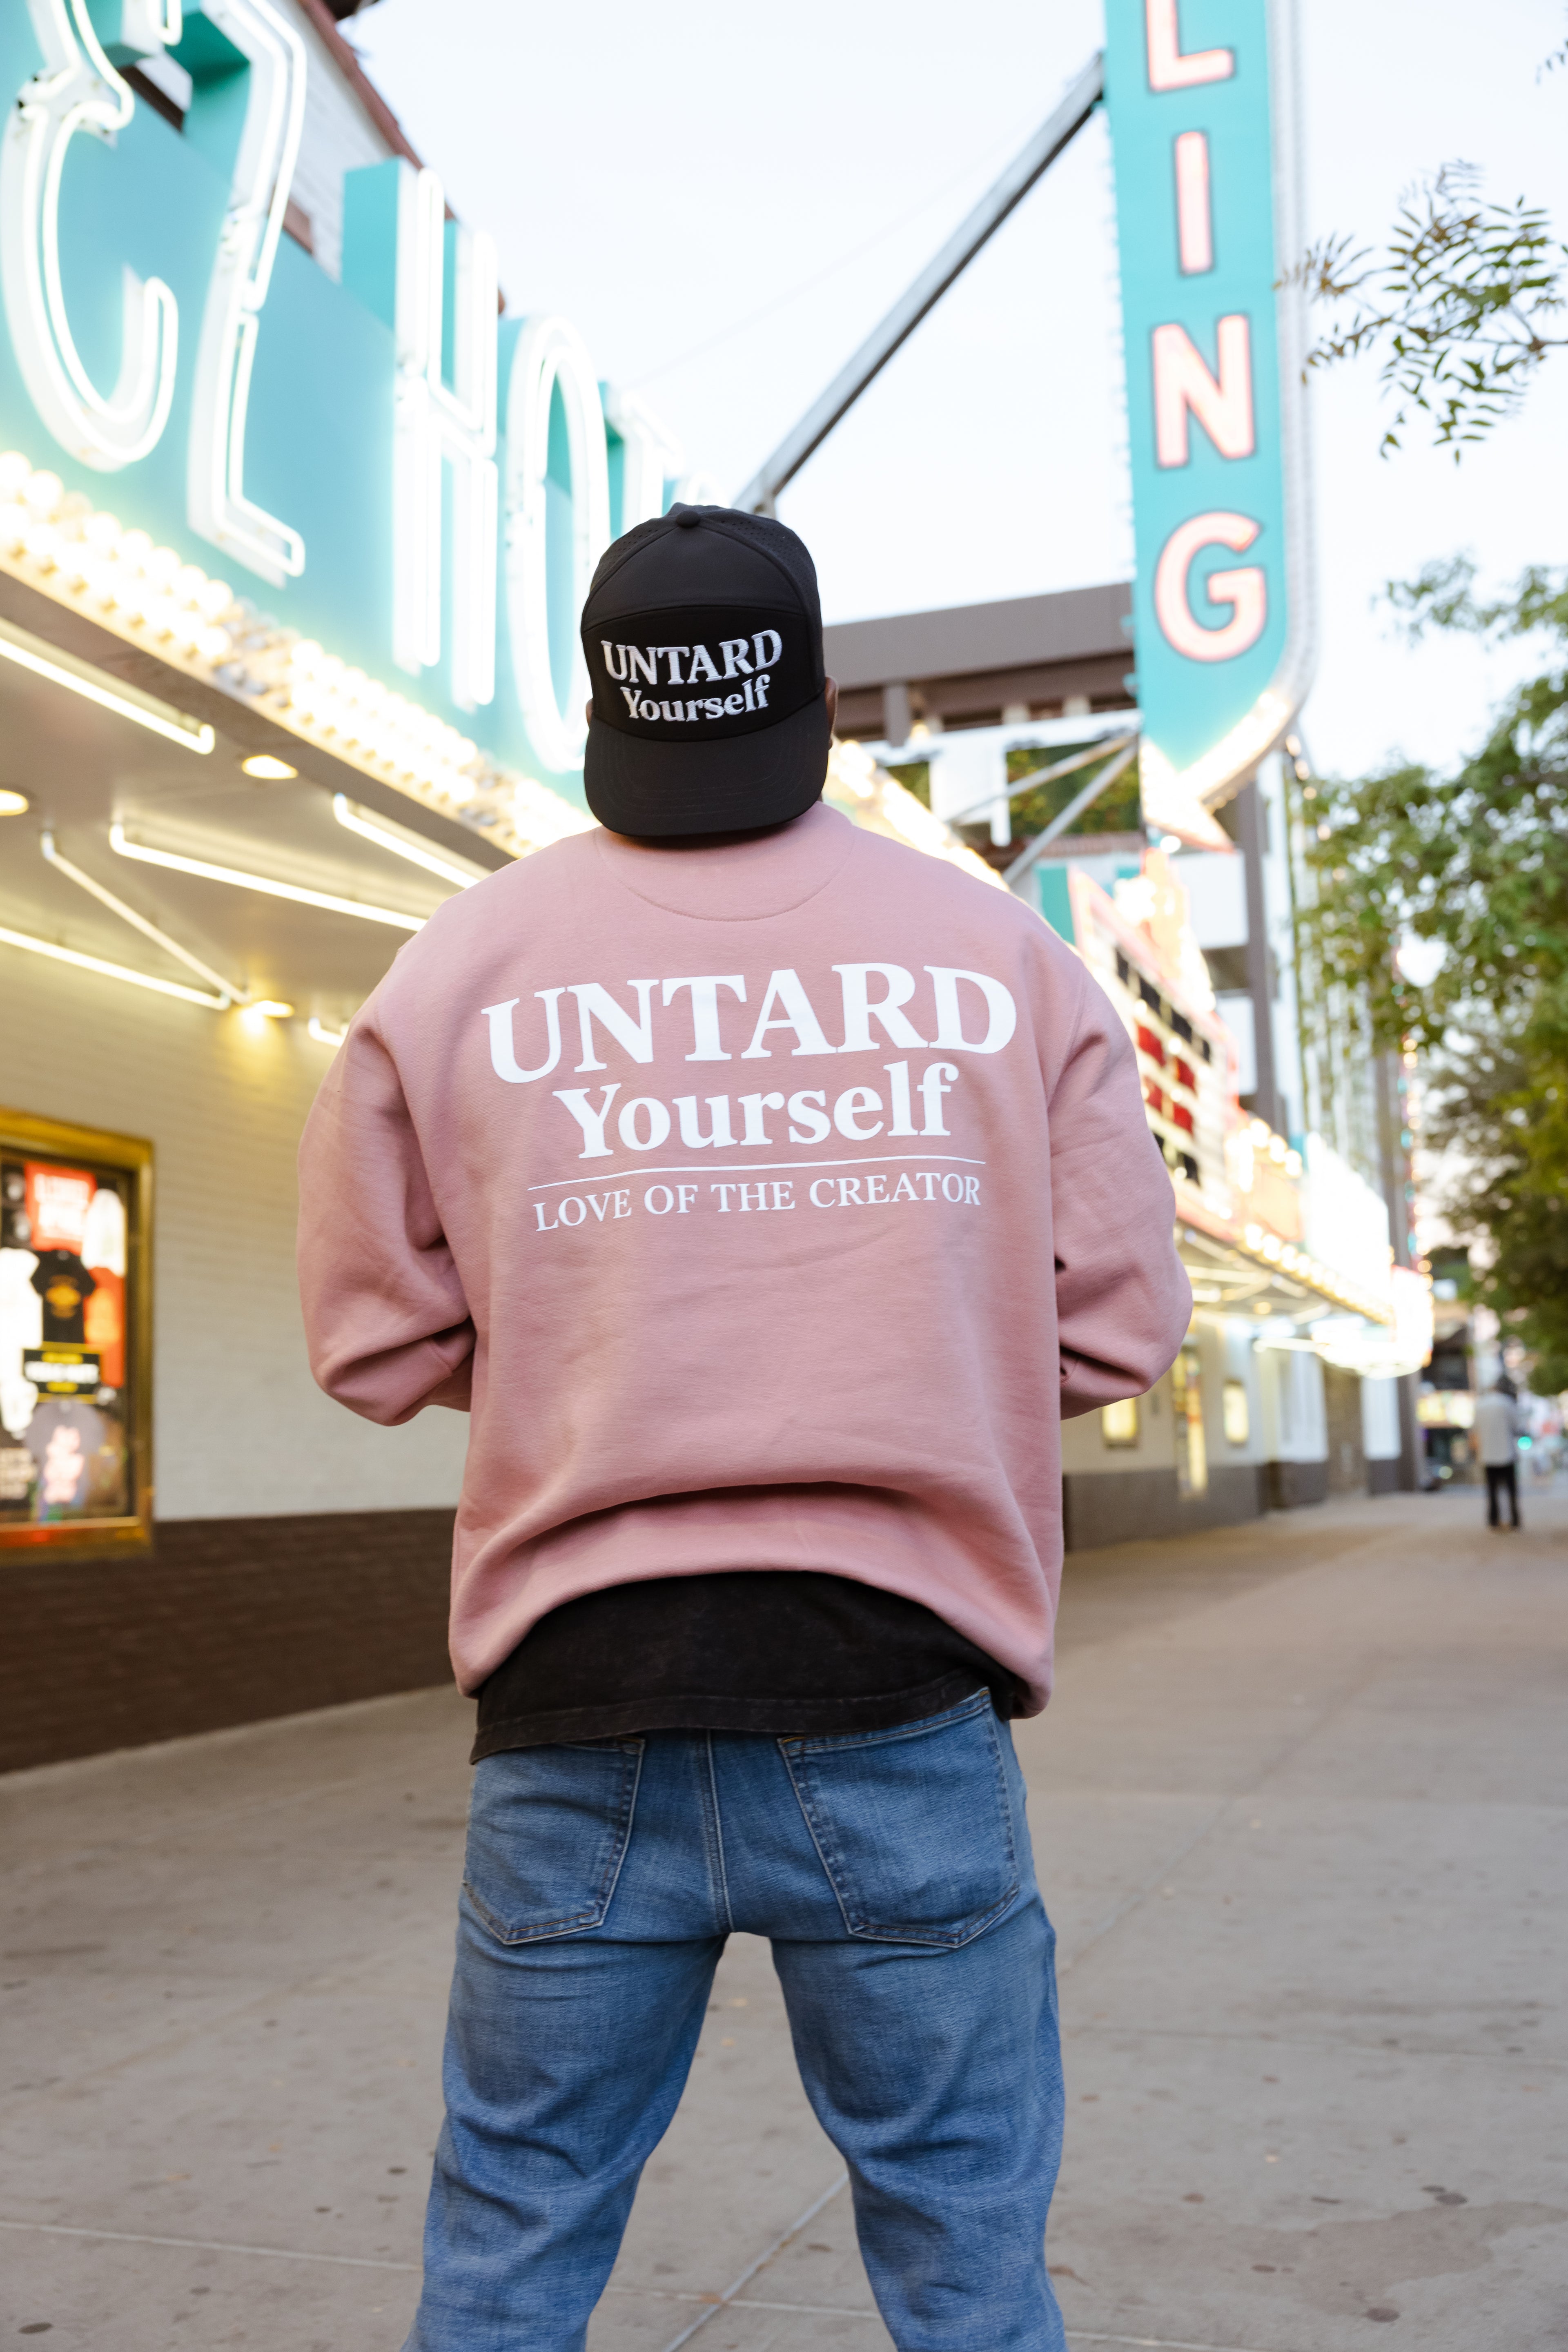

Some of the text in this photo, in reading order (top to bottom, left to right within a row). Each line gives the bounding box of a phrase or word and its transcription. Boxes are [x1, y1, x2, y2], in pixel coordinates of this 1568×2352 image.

[1145, 0, 1267, 663] LING
[601, 629, 783, 685] UNTARD
[620, 674, 770, 722] Yourself
[481, 963, 1017, 1083] UNTARD
[552, 1060, 959, 1159] Yourself
[532, 1172, 981, 1232] LOVE OF THE CREATOR
